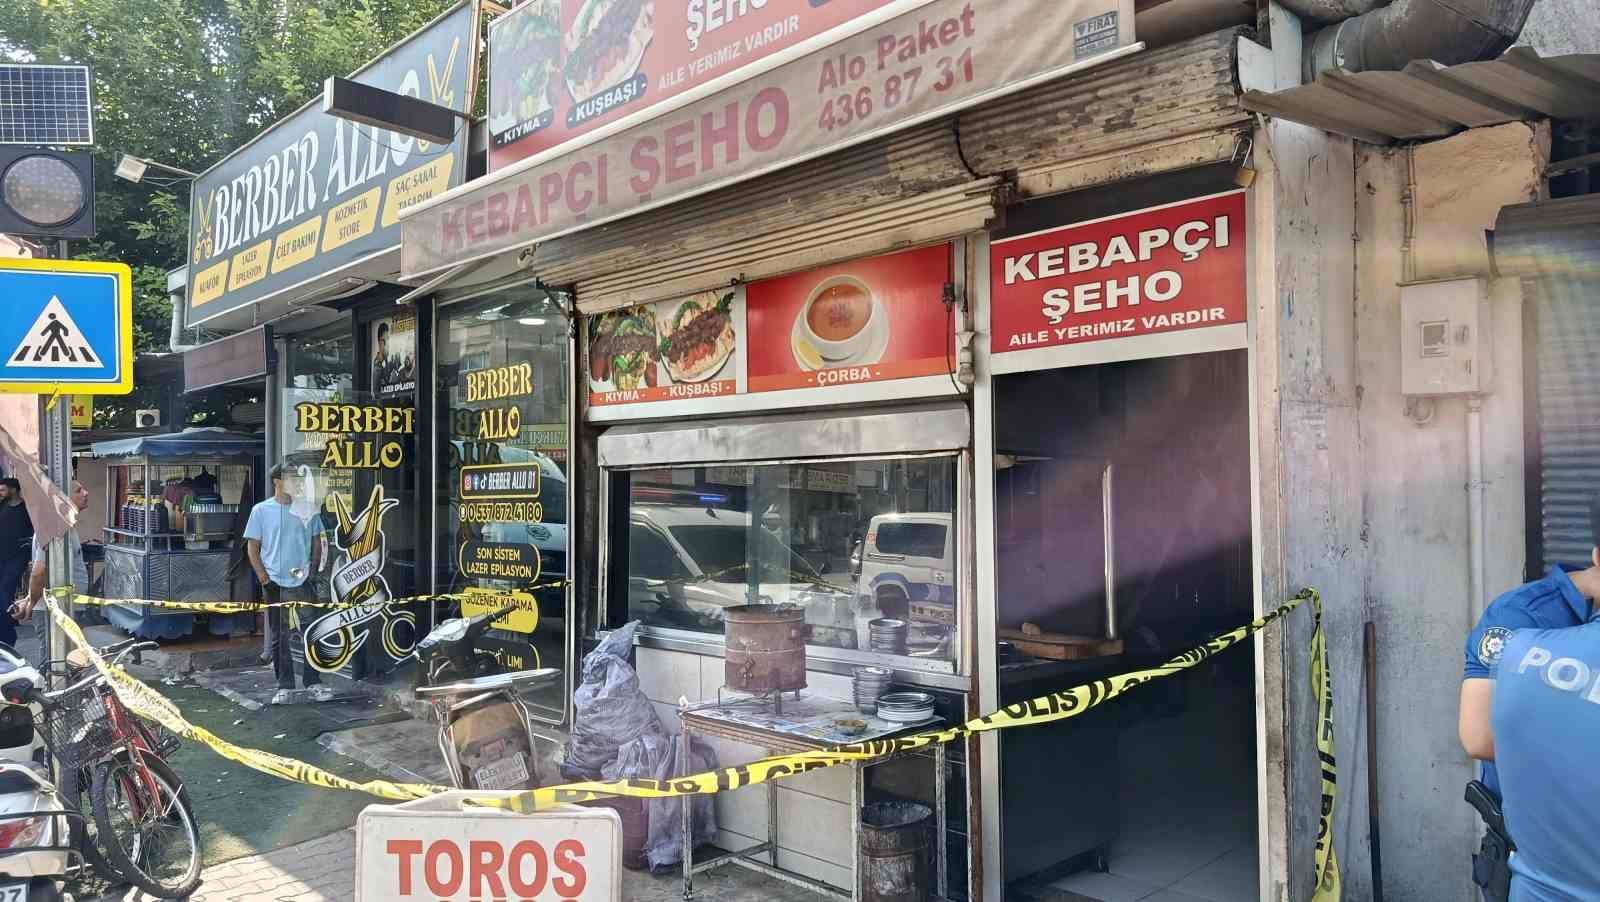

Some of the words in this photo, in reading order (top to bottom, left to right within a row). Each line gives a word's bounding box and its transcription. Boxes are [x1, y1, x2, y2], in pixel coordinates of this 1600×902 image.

[686, 0, 768, 52] ŞEH
[744, 14, 800, 52] VARDIR
[817, 54, 866, 95] Alo
[877, 3, 976, 72] Paket
[576, 83, 638, 121] KUŞBAŞI
[817, 86, 873, 132] 436
[883, 66, 923, 109] 87
[933, 48, 974, 93] 31
[503, 117, 541, 144] KIYMA
[213, 130, 320, 258] BERBER
[322, 69, 420, 203] ALLO
[441, 153, 609, 256] KEBAPÇI
[630, 86, 790, 202] ŞEHO
[339, 220, 361, 241] STORE
[1003, 215, 1230, 286] KEBAPÇI
[1041, 270, 1183, 325] ŞEHO
[1141, 307, 1226, 330] VARDIR
[466, 363, 533, 402] BERBER
[669, 381, 723, 398] KUŞBAŞI
[816, 367, 871, 387] ÇORBA
[604, 389, 640, 404] KIYMA
[478, 406, 521, 440] ALLO
[320, 440, 403, 469] ALLO
[488, 472, 511, 490] BERBER
[512, 471, 528, 490] ALLO
[528, 470, 536, 490] 01
[466, 562, 489, 575] LAZER
[490, 563, 532, 578] EPİLASYON
[476, 547, 492, 560] SON
[494, 546, 520, 561] SİSTEM
[342, 560, 375, 584] BERBER
[386, 838, 587, 899] TOROS
